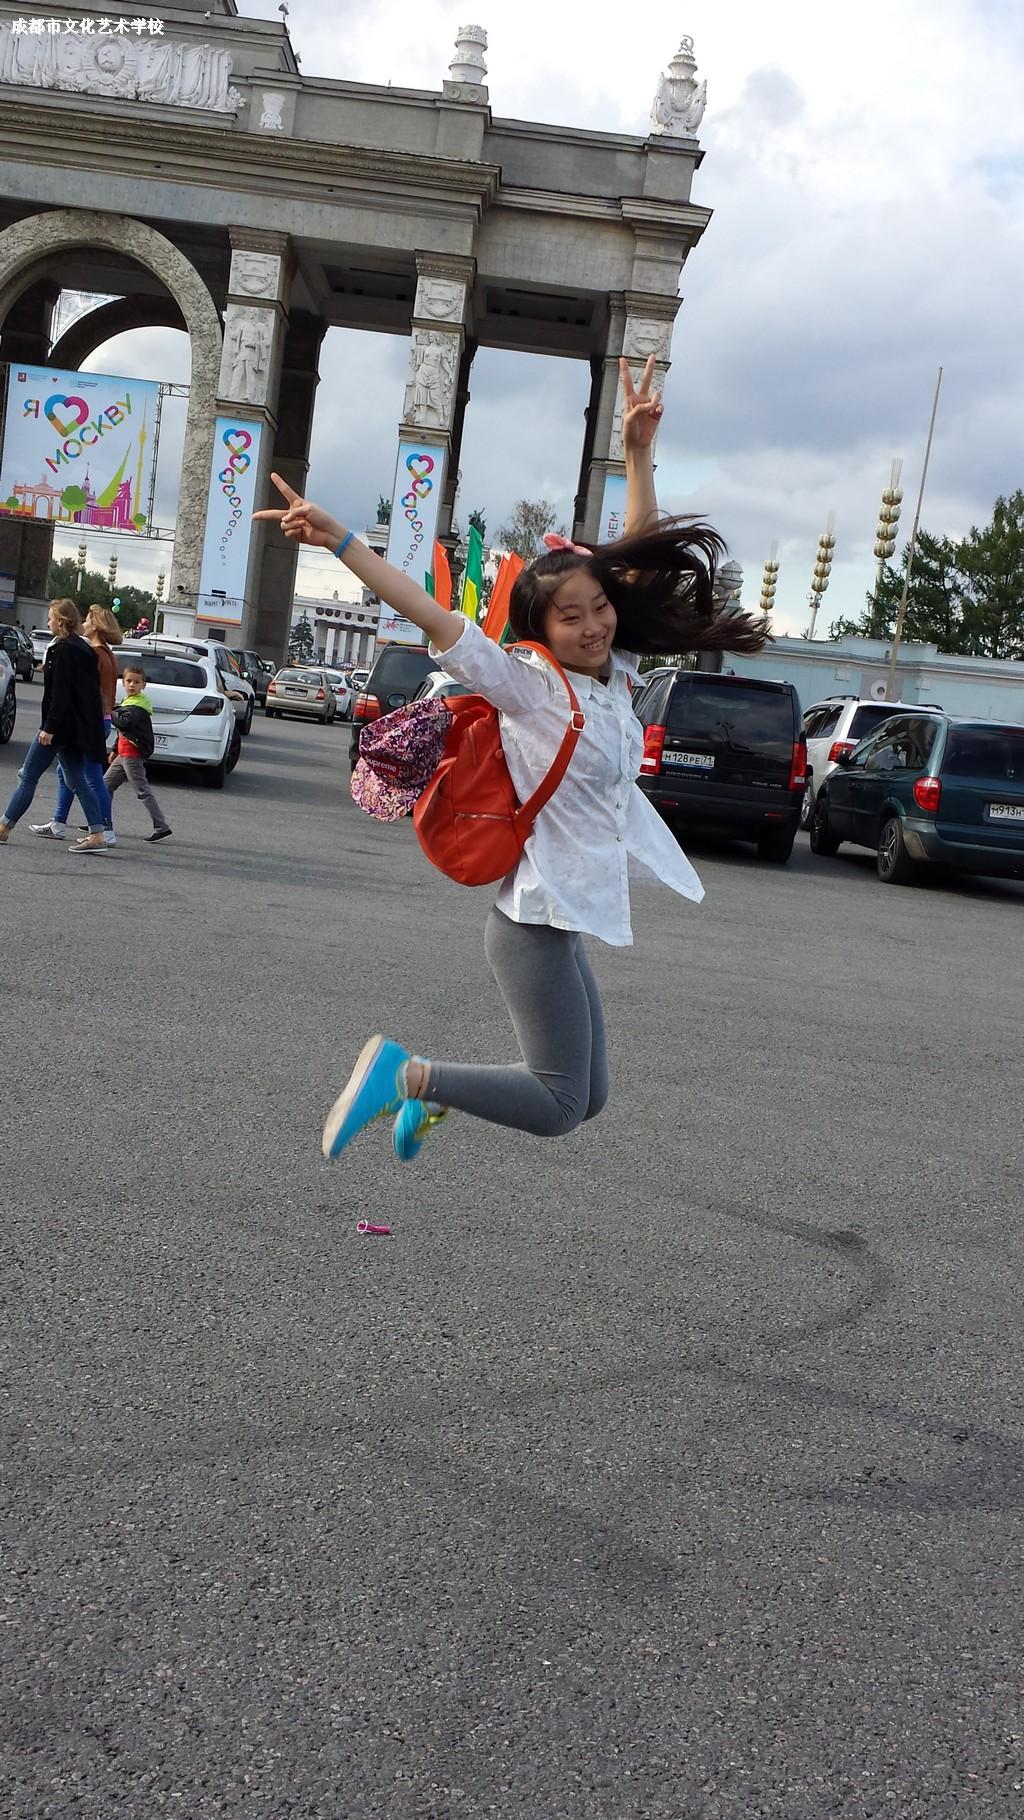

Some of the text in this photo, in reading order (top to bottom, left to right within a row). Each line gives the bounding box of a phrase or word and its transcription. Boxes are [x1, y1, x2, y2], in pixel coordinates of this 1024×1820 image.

[23, 399, 39, 419] Я
[45, 393, 132, 473] МОСКВУ
[365, 755, 397, 772] Supreme
[992, 805, 1024, 817] М913Н
